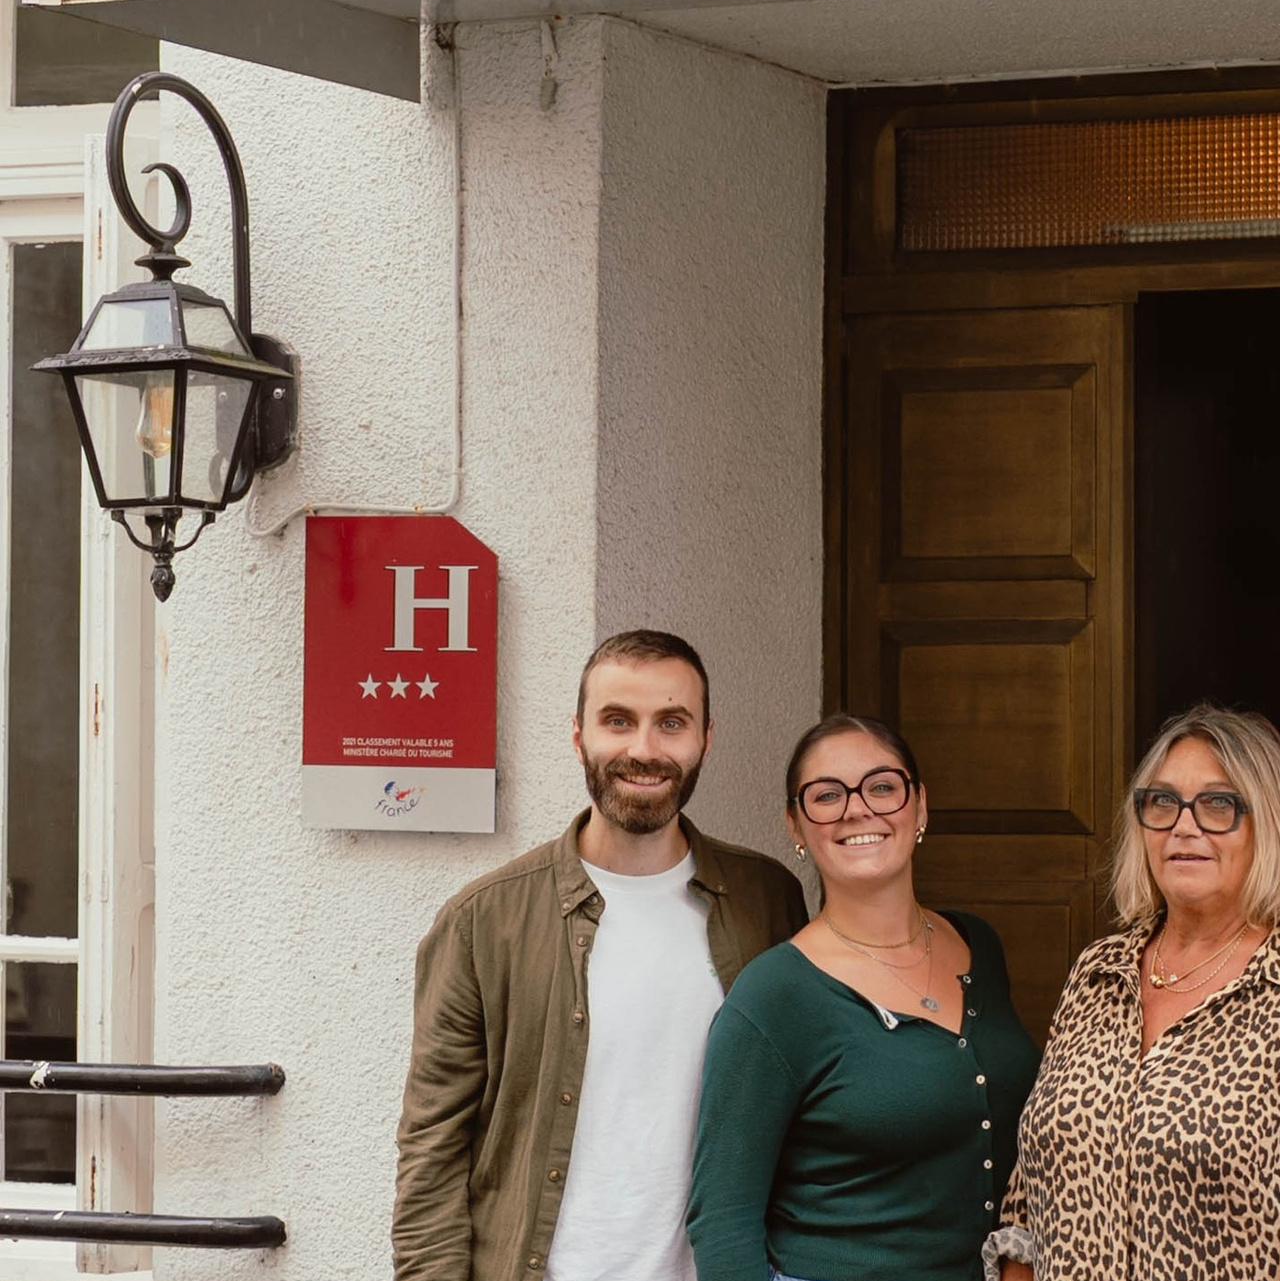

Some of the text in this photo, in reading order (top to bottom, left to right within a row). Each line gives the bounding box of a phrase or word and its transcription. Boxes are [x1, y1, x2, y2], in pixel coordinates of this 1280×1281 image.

[382, 565, 479, 652] H
[357, 737, 400, 747] CLASSEMENT
[402, 738, 432, 747] VALABLE
[440, 739, 454, 748] ANS
[407, 748, 418, 758] DU
[419, 748, 453, 758] TOURISME
